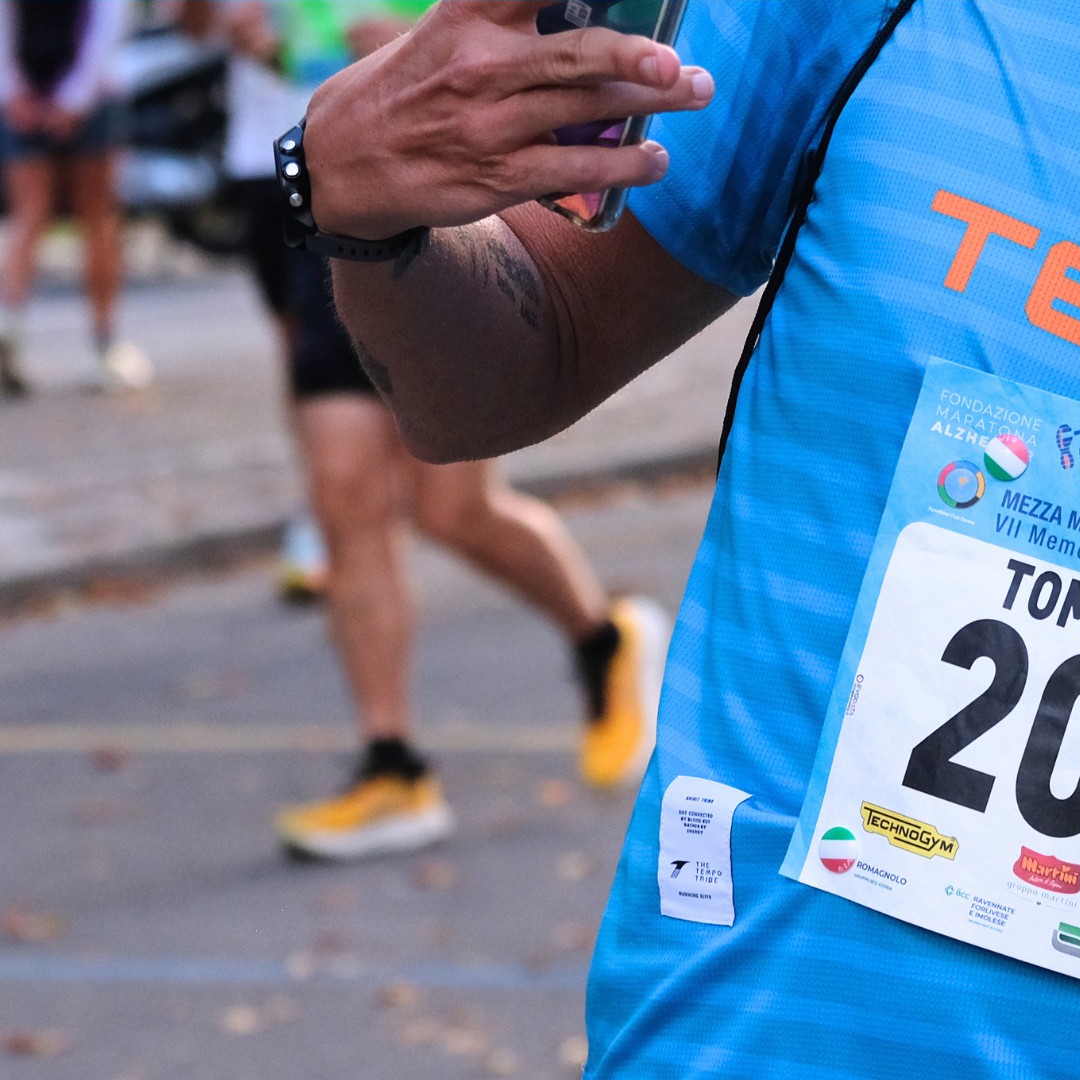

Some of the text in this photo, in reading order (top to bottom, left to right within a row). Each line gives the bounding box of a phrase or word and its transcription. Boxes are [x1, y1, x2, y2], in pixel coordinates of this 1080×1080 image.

[940, 390, 1042, 432] FONDAZIONE
[936, 405, 1036, 447] MARATONA
[1001, 489, 1062, 526] MEZZA
[995, 513, 1022, 539] VII
[695, 875, 718, 884] TRIBE
[696, 868, 722, 877] TEMPO
[856, 861, 907, 886] ROMAGNOLO
[1021, 856, 1078, 885] Martini
[973, 896, 1016, 915] RAVENNATE
[1006, 881, 1038, 897] gruppo
[1041, 890, 1078, 909] martini
[971, 904, 1009, 920] FORLIVESE
[975, 912, 1006, 927] IMOLESE
